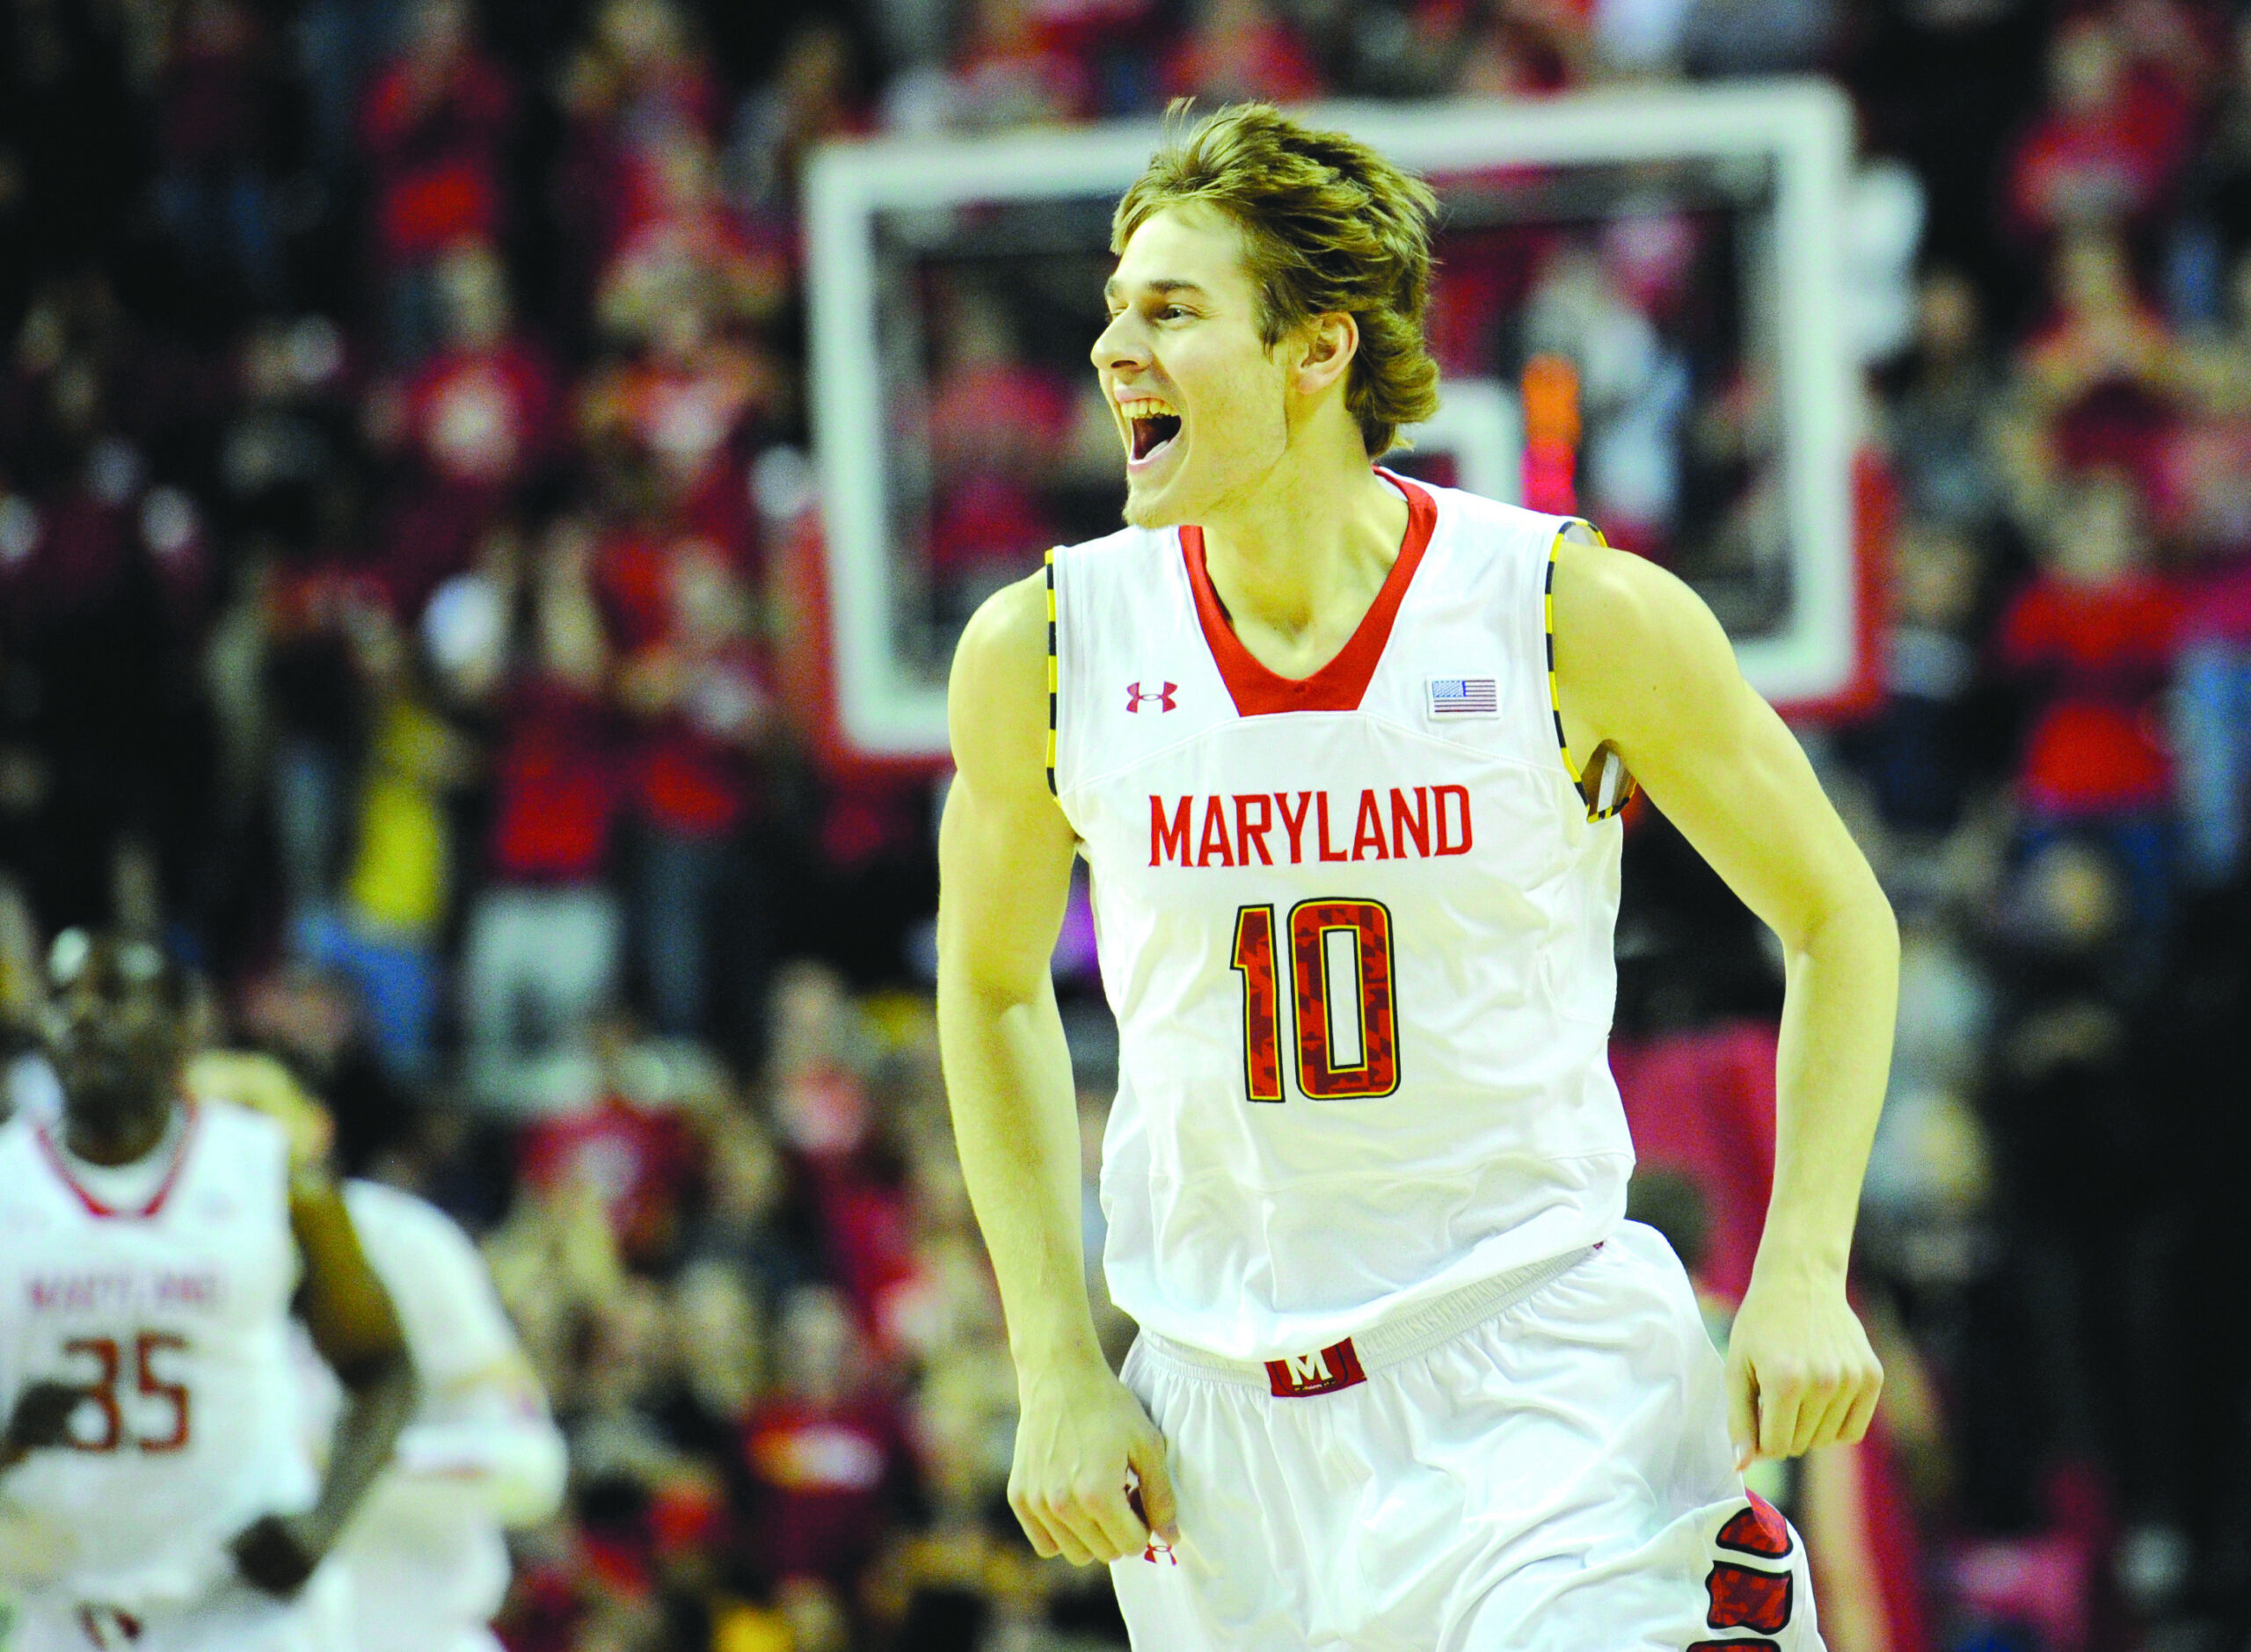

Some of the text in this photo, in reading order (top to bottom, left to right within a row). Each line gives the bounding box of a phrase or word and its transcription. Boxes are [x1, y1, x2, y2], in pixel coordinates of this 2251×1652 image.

[1148, 784, 1473, 867] MARYLAND
[1230, 897, 1401, 1103] 10
[63, 1329, 192, 1454] 35
[1284, 1350, 1334, 1386] M
